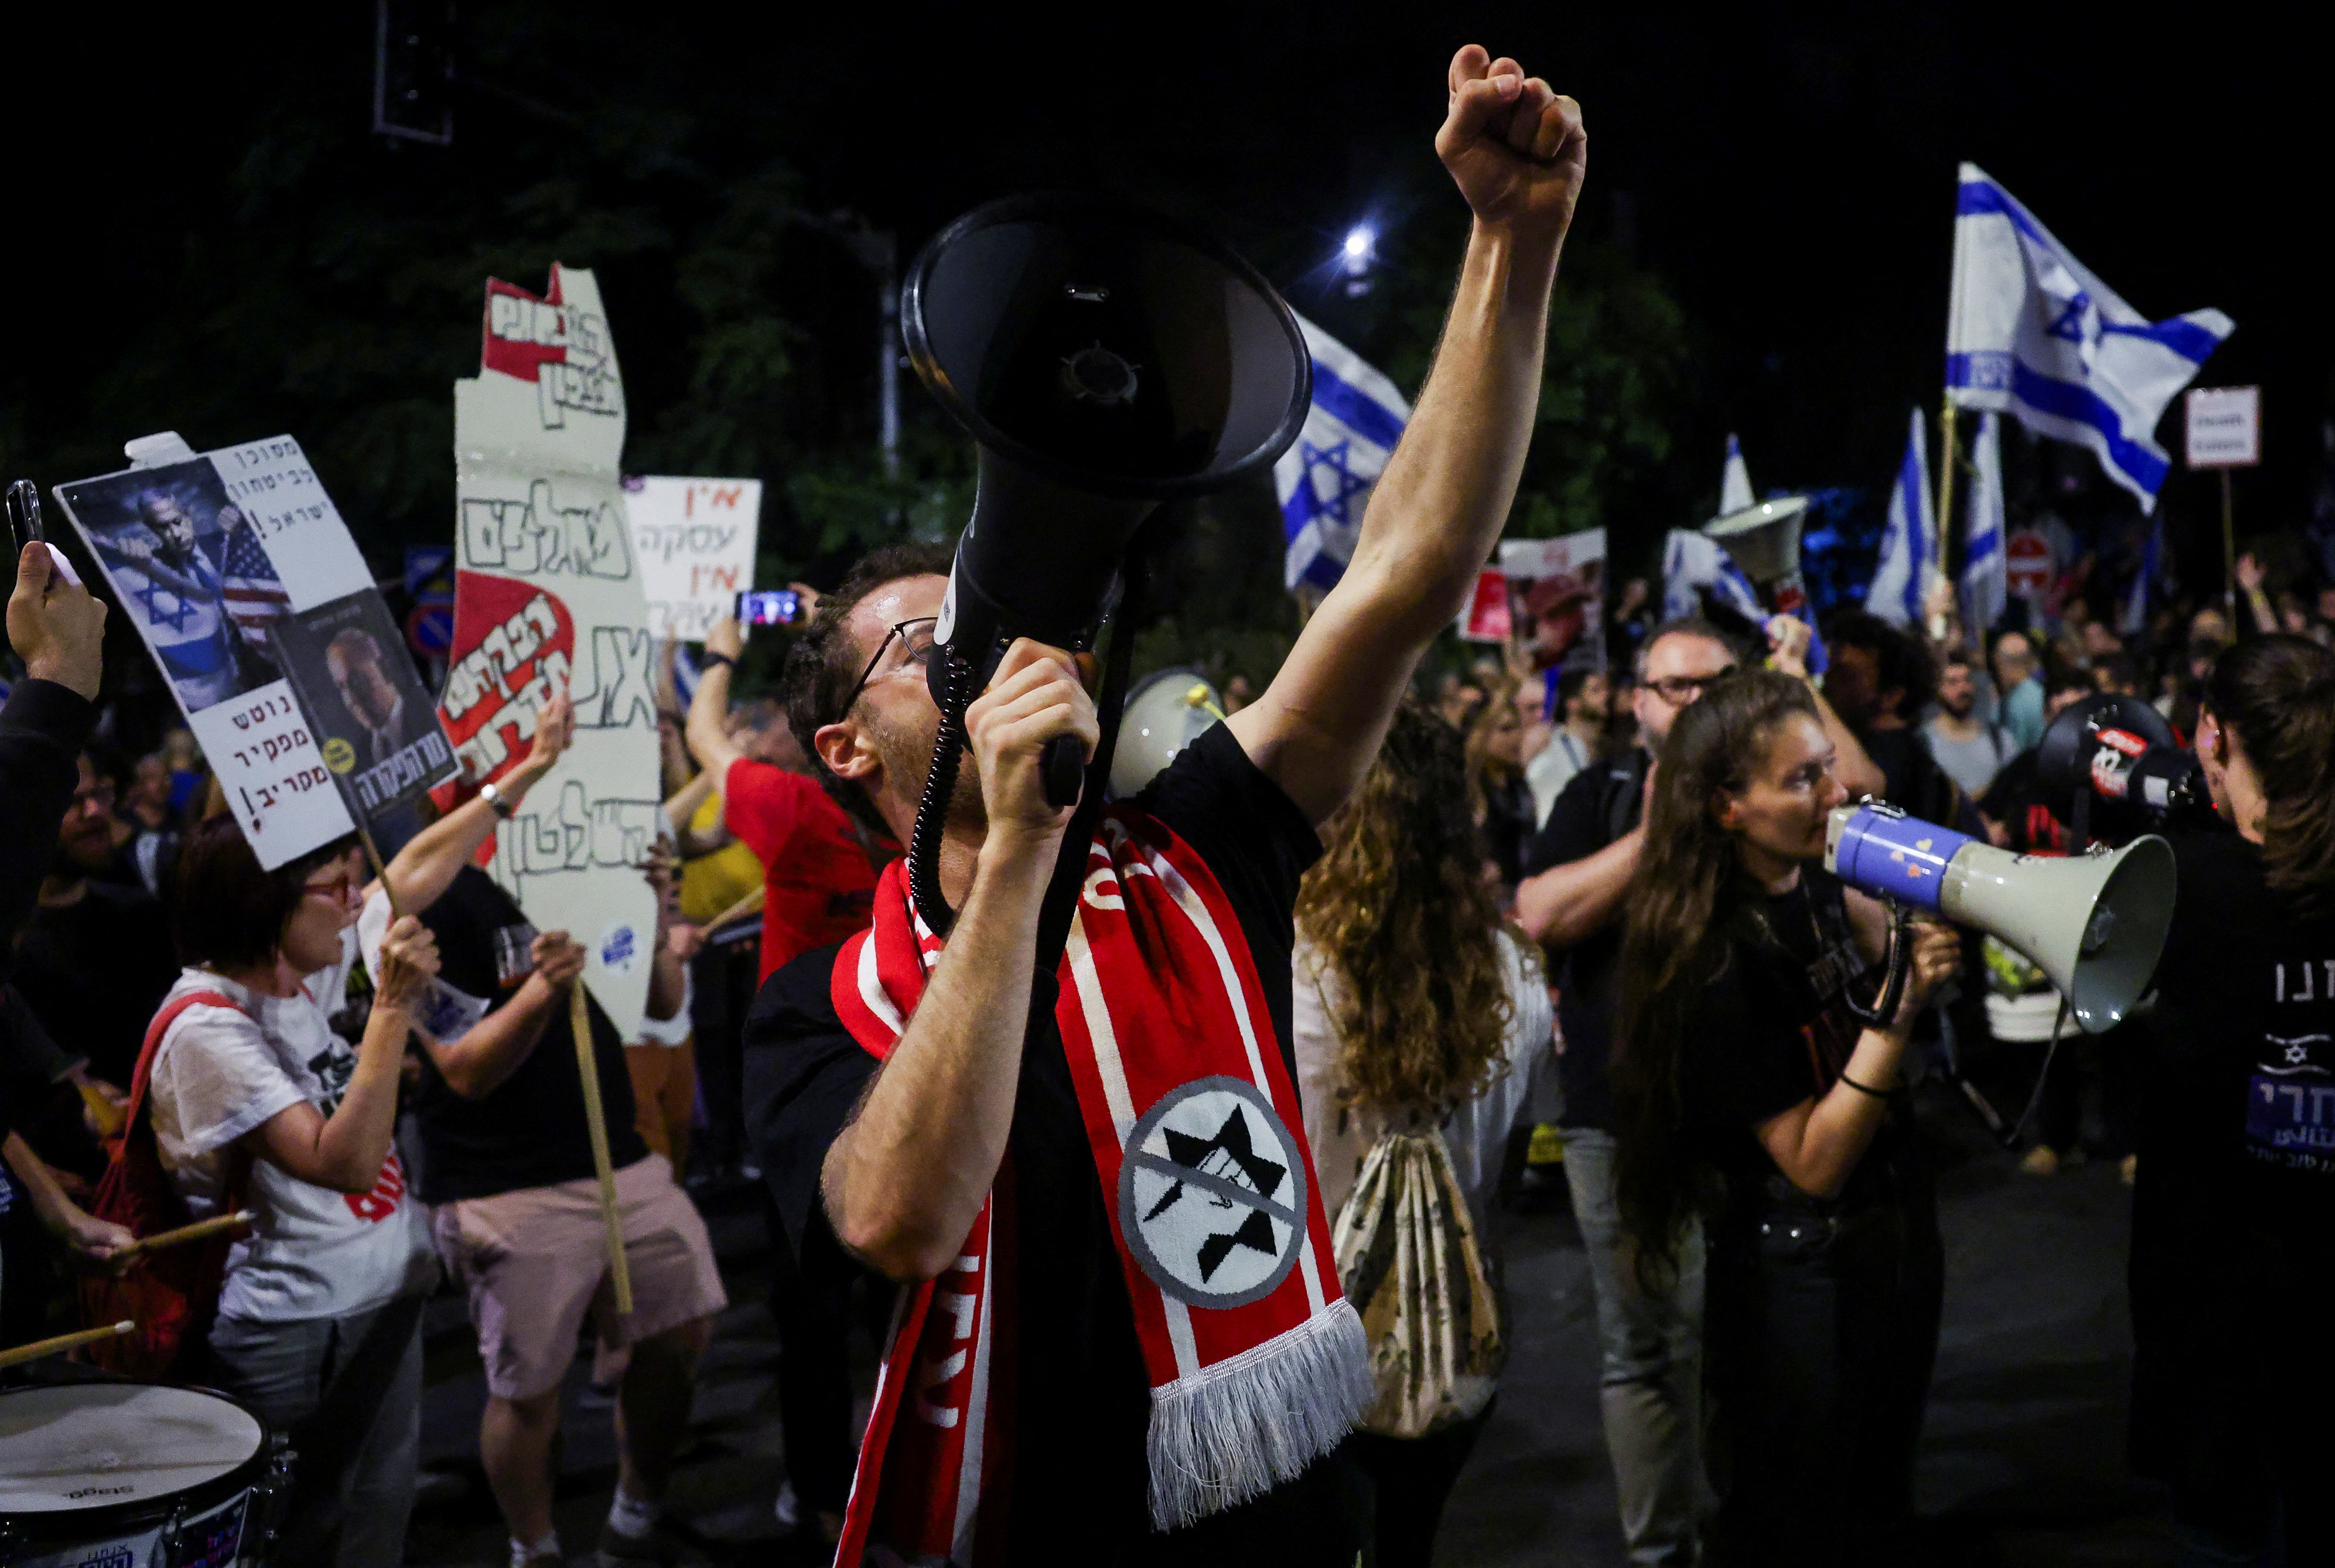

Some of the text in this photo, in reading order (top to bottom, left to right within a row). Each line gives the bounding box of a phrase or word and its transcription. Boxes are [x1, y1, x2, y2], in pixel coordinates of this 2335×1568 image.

[234, 442, 298, 468] מסוכן
[229, 469, 312, 500] לביטחון
[685, 485, 743, 517] אין
[250, 501, 327, 539] ישראל!
[638, 524, 738, 564] עסקה
[690, 565, 740, 597] אין
[233, 696, 291, 729] נוטש
[235, 729, 309, 767] מפקיר
[239, 766, 328, 834] מקריב!
